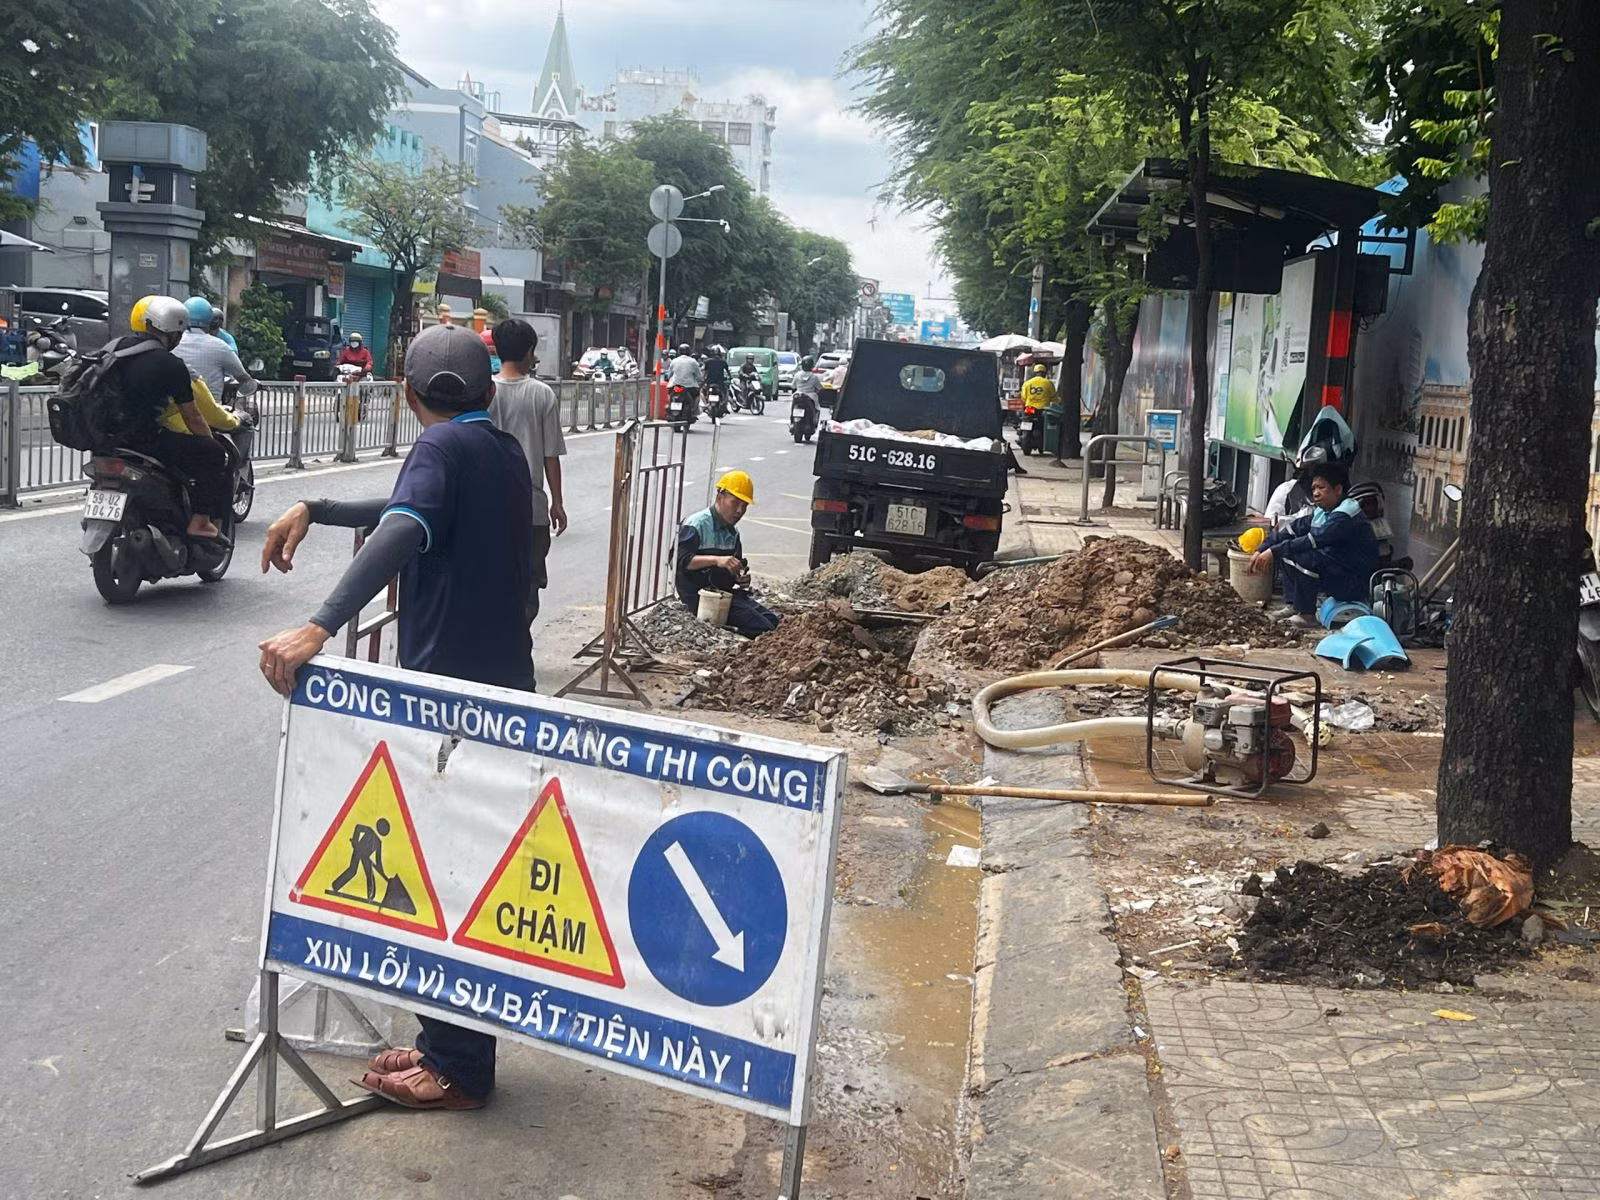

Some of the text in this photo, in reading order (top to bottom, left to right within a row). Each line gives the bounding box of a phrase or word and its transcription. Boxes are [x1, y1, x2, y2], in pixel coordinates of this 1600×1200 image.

[1029, 384, 1044, 396] be
[848, 444, 877, 462] 51C
[896, 506, 918, 520] 51C
[305, 672, 809, 804] CÔNG TRƯỜNG ĐANG THI CÔNG
[530, 857, 561, 895] ĐI
[496, 901, 586, 955] CHẬM
[304, 936, 352, 975] XIN
[358, 945, 410, 989] LỖI
[416, 963, 445, 1000] VÌ
[450, 977, 497, 1017] SỰ
[499, 989, 567, 1035] BẤT
[576, 1012, 651, 1060] TIỆN
[659, 1035, 732, 1085] NÀY
